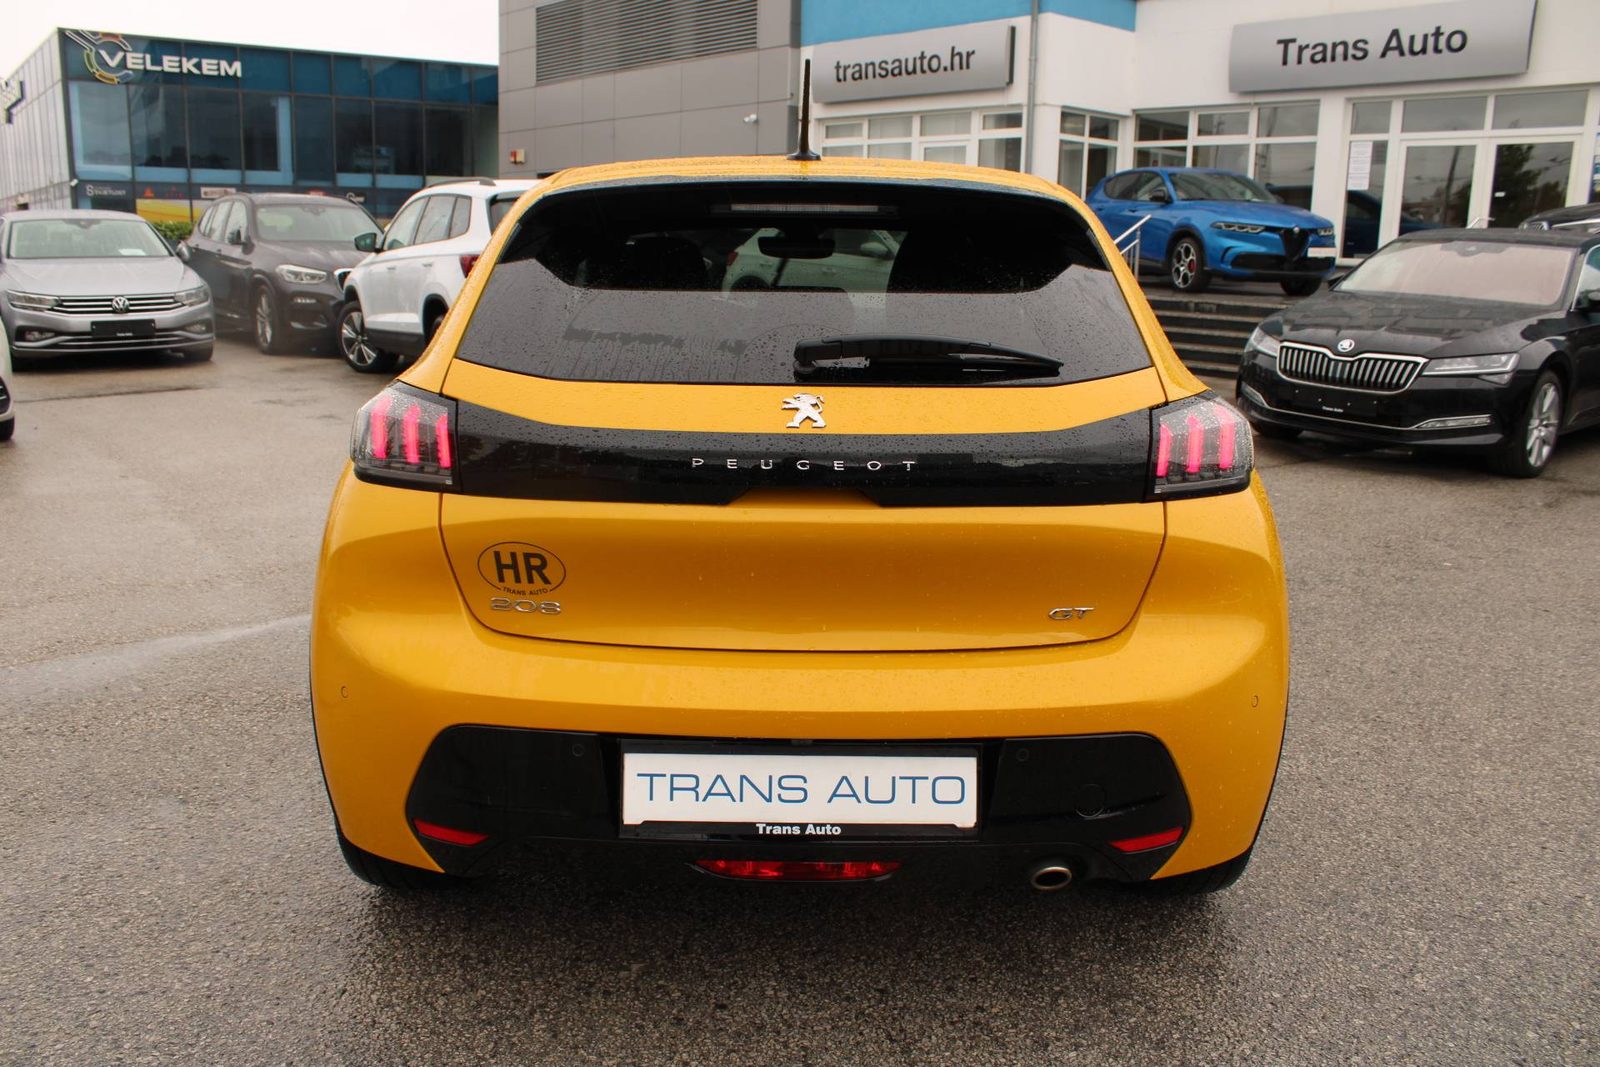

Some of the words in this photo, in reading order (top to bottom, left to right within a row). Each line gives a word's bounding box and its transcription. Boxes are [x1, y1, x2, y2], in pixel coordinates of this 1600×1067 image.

[1276, 37, 1369, 66] Trans
[1379, 25, 1468, 59] Auto
[98, 49, 242, 78] VELEKEM
[834, 46, 976, 83] transauto.hr
[691, 457, 916, 472] PEUGEOT
[493, 550, 552, 585] HR
[503, 586, 527, 596] TRANS
[529, 587, 549, 596] AUTO
[490, 596, 562, 615] 208
[1048, 606, 1096, 620] GT
[636, 773, 809, 804] TRANS
[827, 775, 966, 805] AUTO
[756, 823, 801, 836] Trans
[804, 823, 842, 836] Auto
